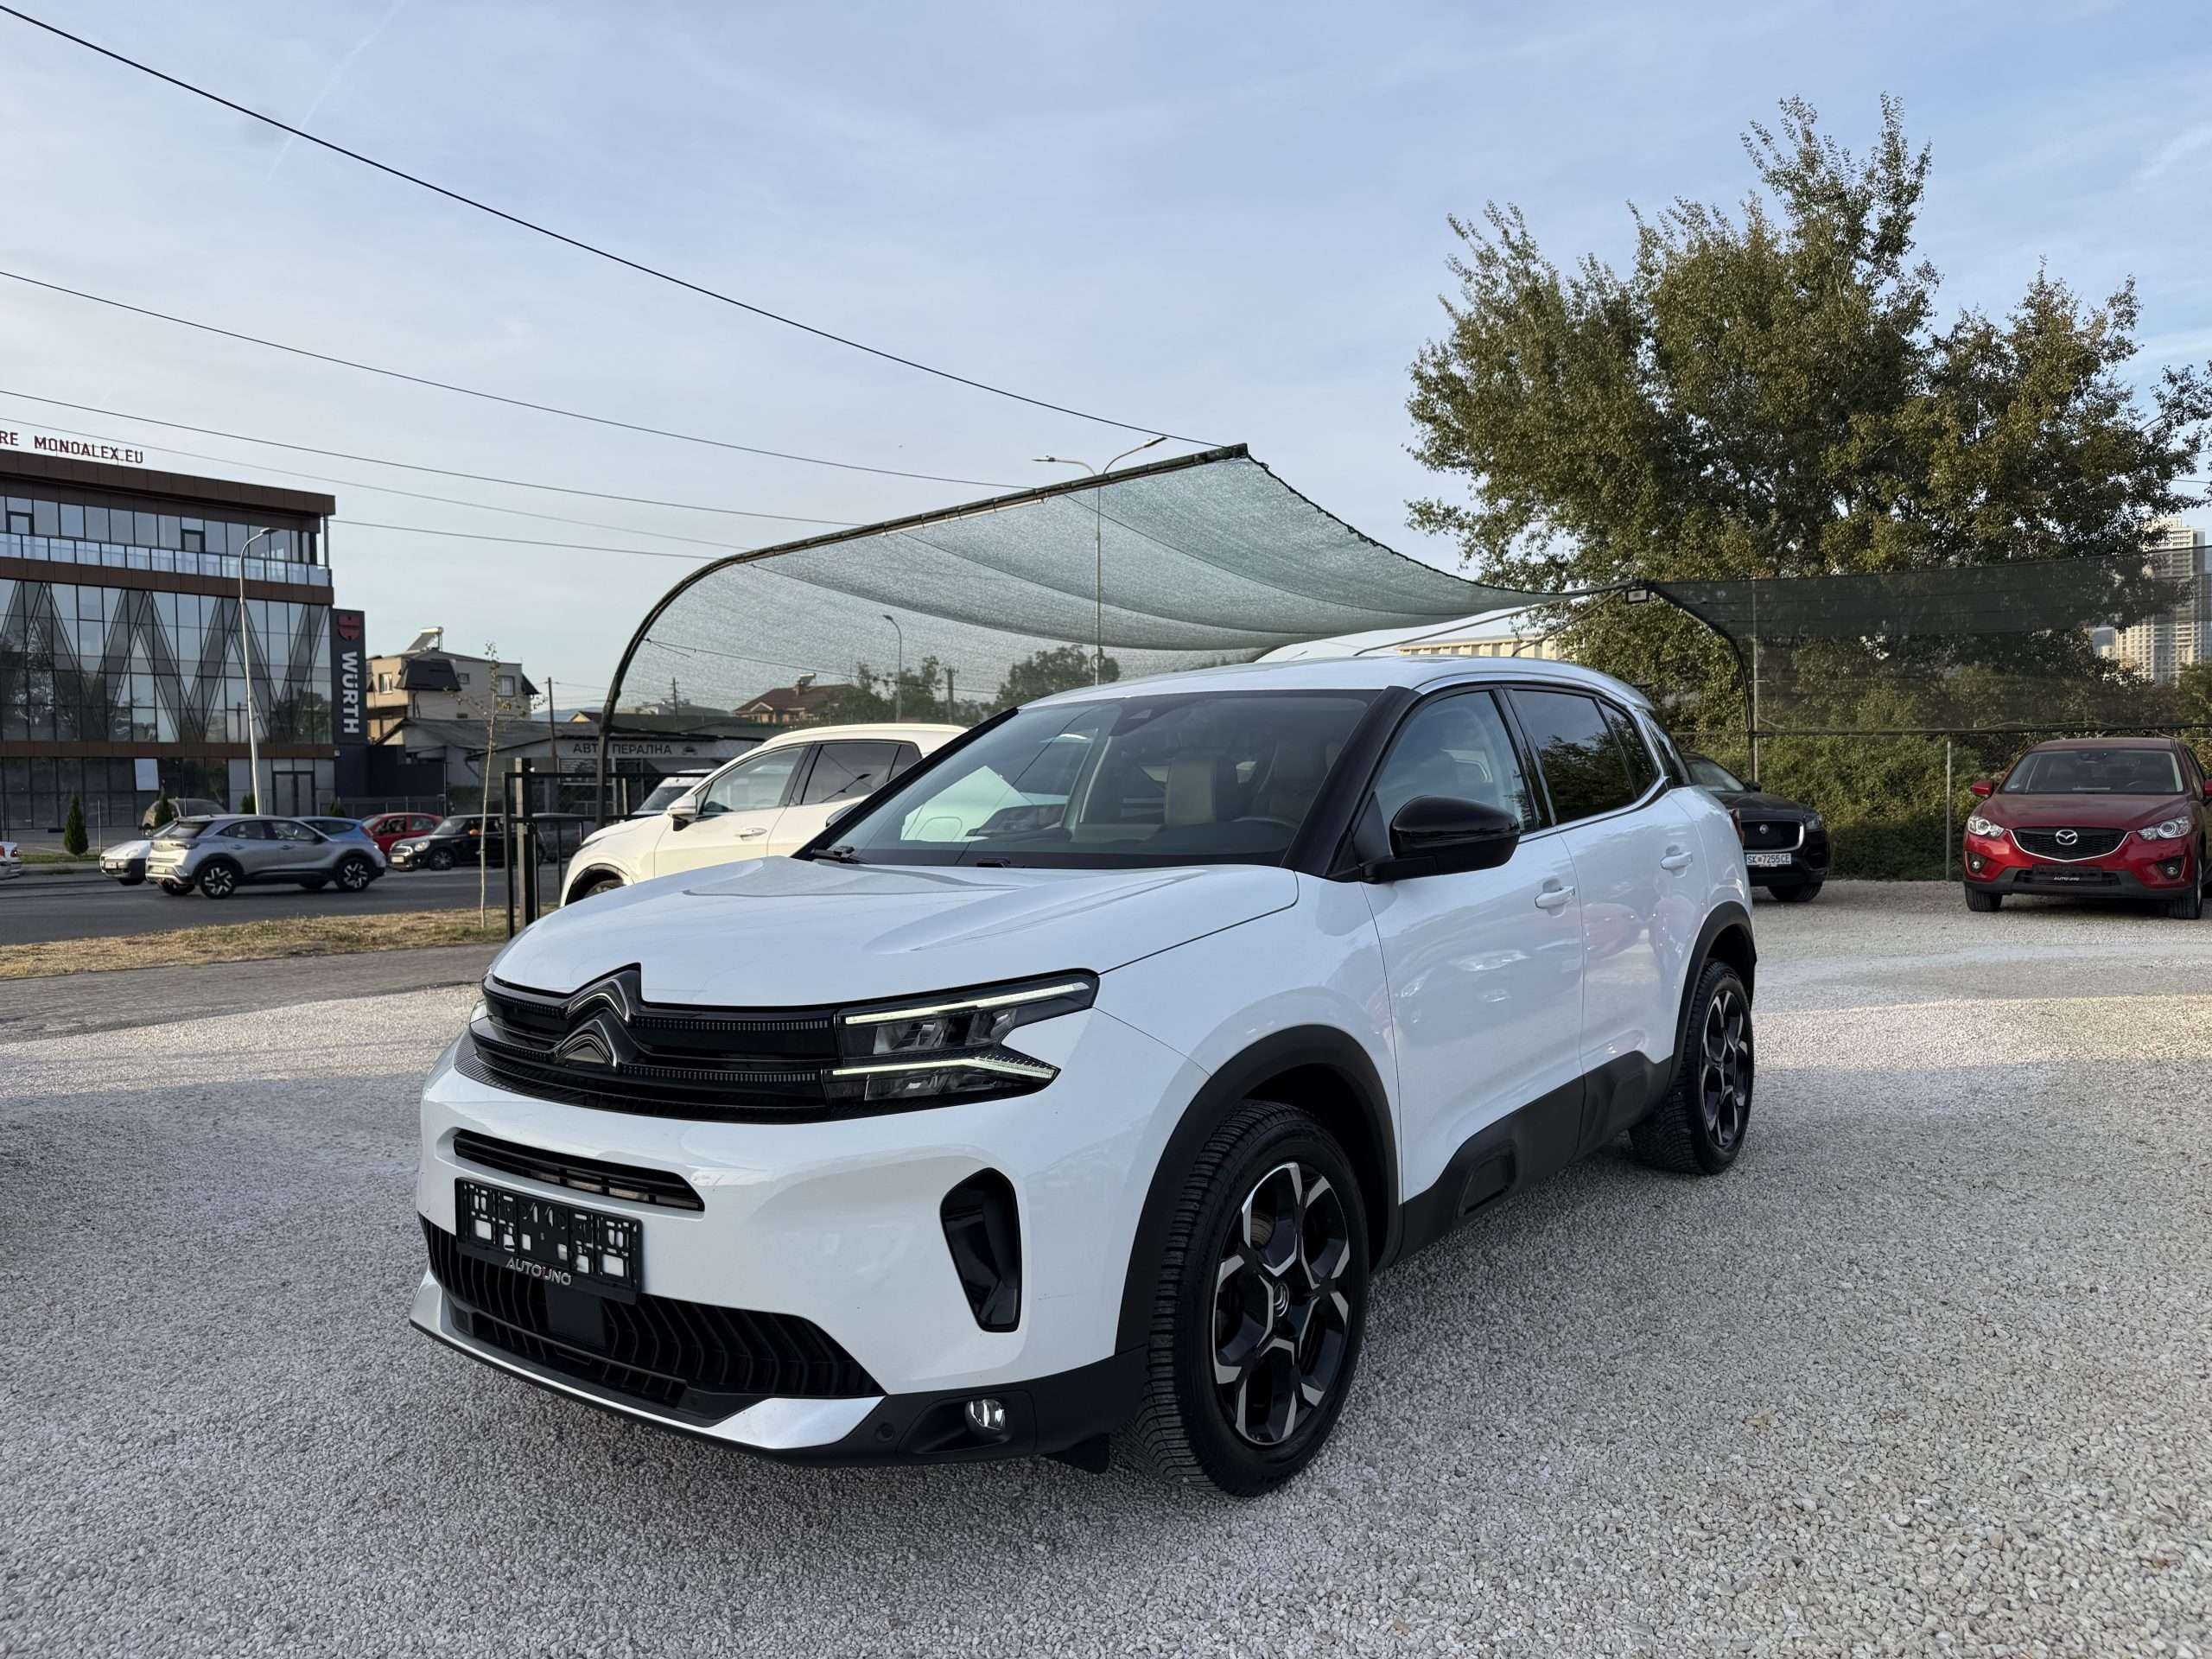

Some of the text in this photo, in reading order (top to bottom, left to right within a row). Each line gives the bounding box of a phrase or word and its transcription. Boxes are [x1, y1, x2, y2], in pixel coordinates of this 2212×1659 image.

[34, 435, 143, 464] MONOALEX.EU
[341, 651, 360, 734] WÜRTH
[573, 742, 672, 755] АВТ ПЕРАЛНА
